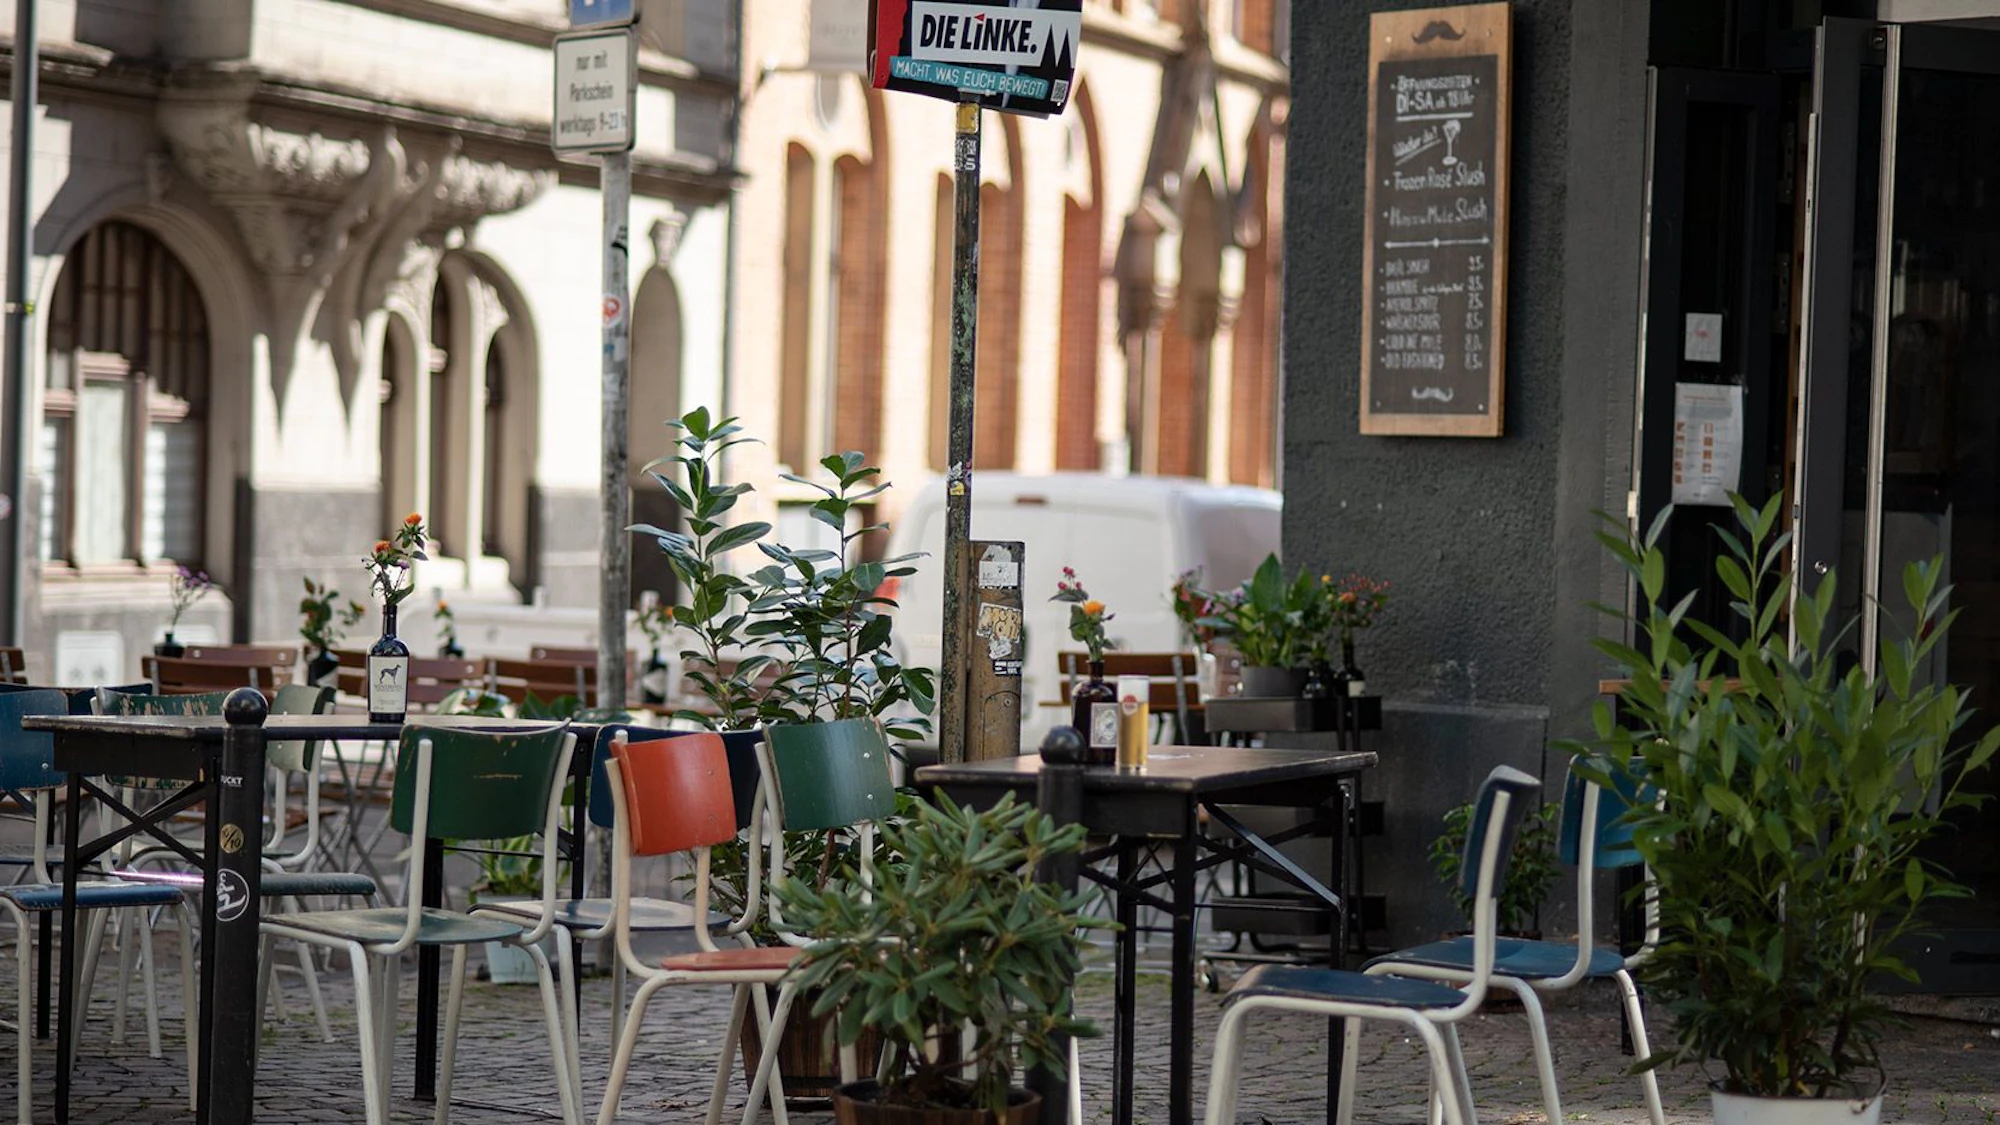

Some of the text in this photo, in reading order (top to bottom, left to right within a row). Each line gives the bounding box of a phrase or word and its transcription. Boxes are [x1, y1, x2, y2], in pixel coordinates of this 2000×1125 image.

[920, 14, 958, 48] DIE
[571, 82, 613, 102] Parkschein
[936, 67, 959, 84] WAS
[964, 71, 995, 89] EUCH
[1000, 76, 1046, 97] BEWEGT!
[560, 114, 596, 137] werktags
